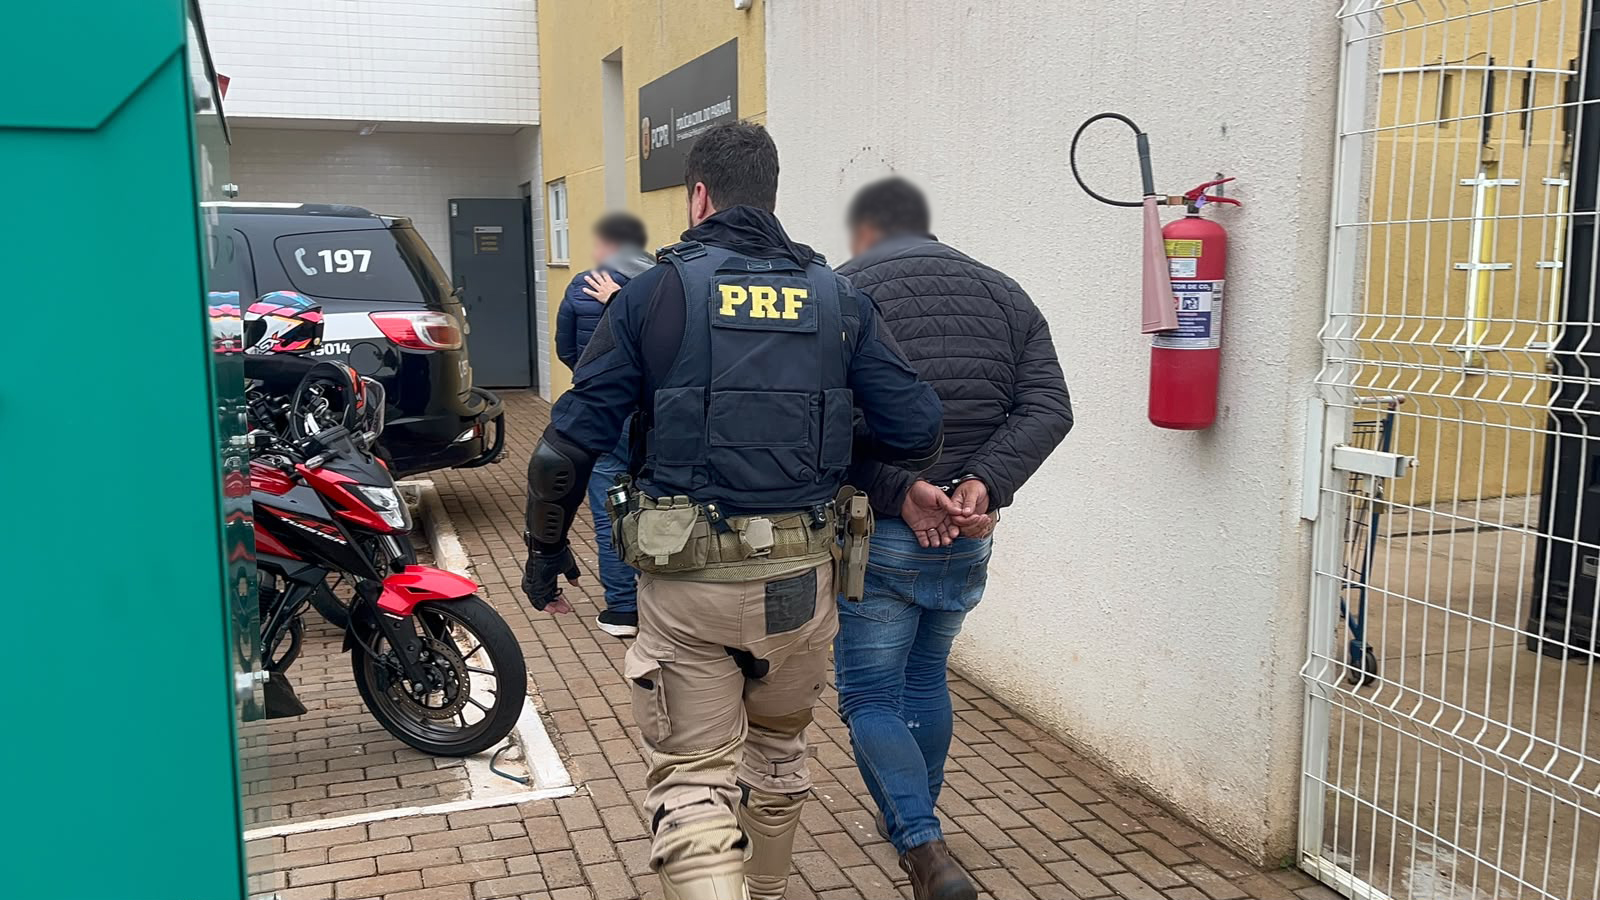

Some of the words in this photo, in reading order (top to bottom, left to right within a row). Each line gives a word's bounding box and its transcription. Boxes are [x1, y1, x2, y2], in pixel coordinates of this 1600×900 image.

[651, 123, 669, 150] PCPR
[318, 249, 372, 273] 197
[718, 284, 808, 320] PRF
[280, 516, 348, 546] TWISTER
